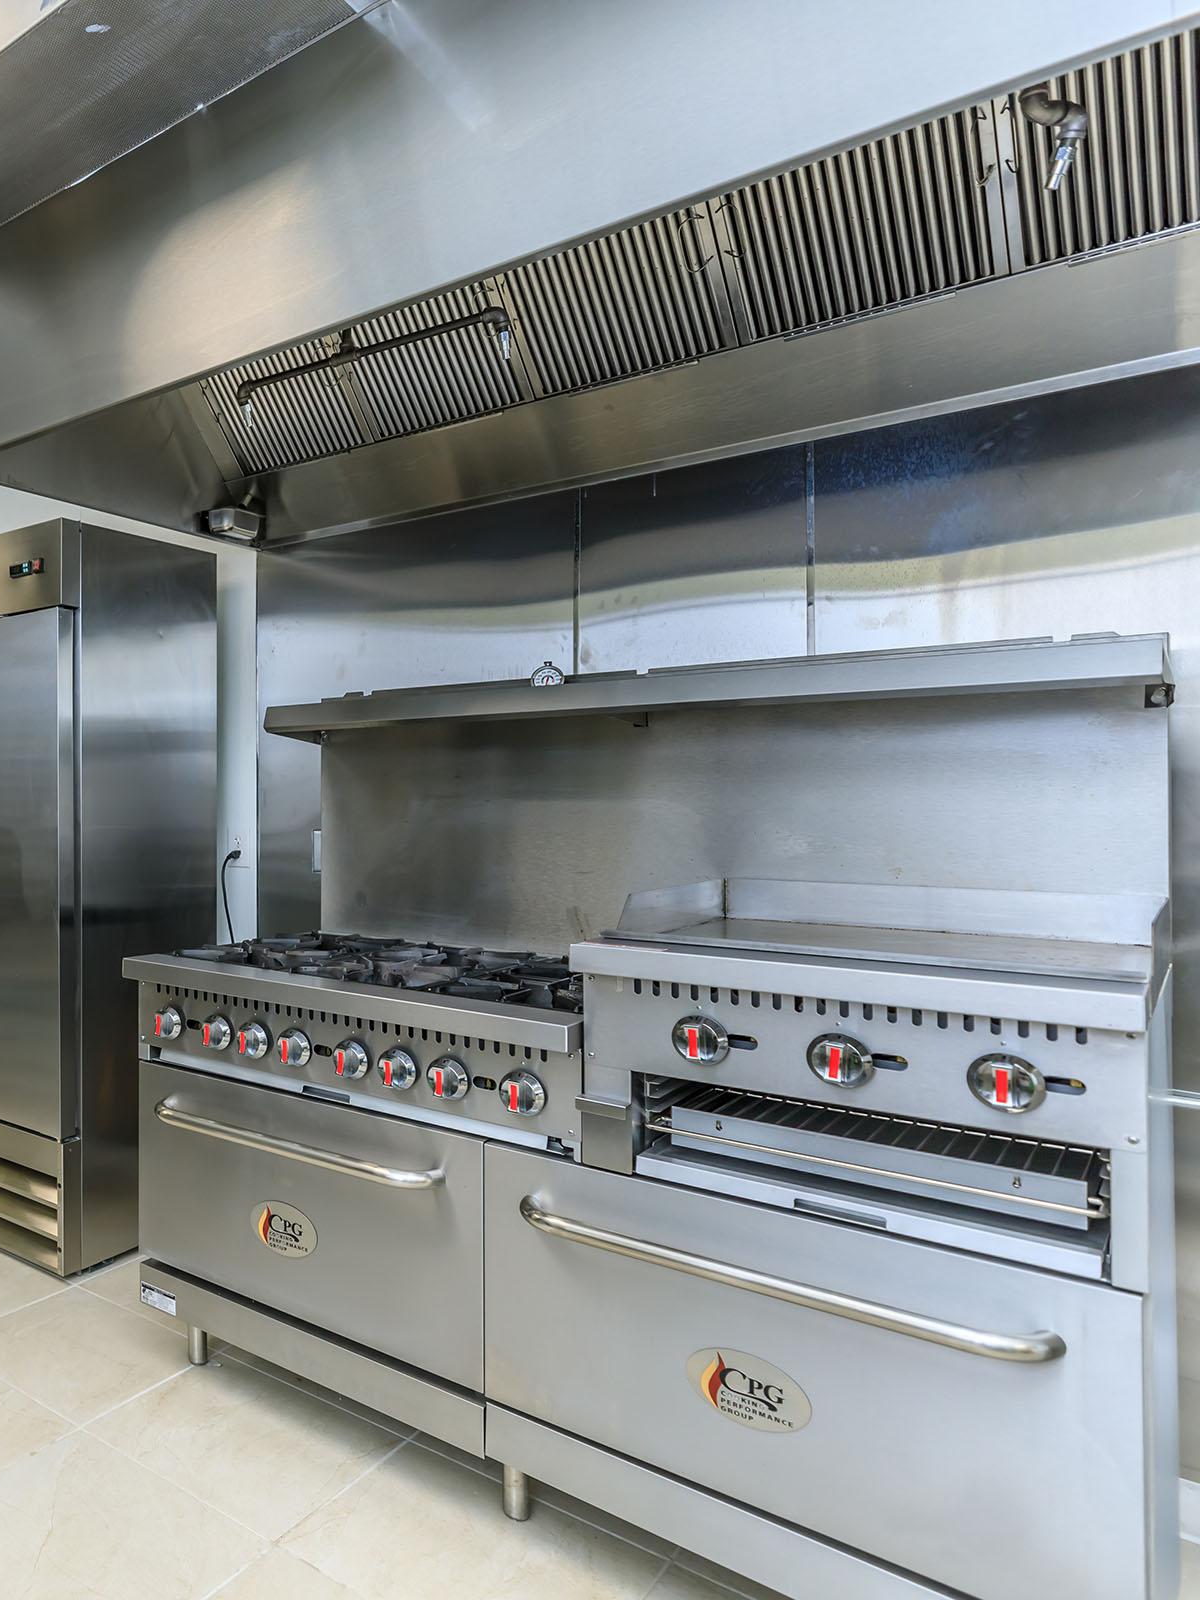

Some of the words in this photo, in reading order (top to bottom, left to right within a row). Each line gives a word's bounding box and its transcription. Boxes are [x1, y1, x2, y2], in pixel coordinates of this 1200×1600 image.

[268, 1214, 303, 1243] CPG
[719, 1368, 785, 1411] CPG
[720, 1397, 794, 1428] PERFORMANCE
[720, 1405, 754, 1421] GROUP
